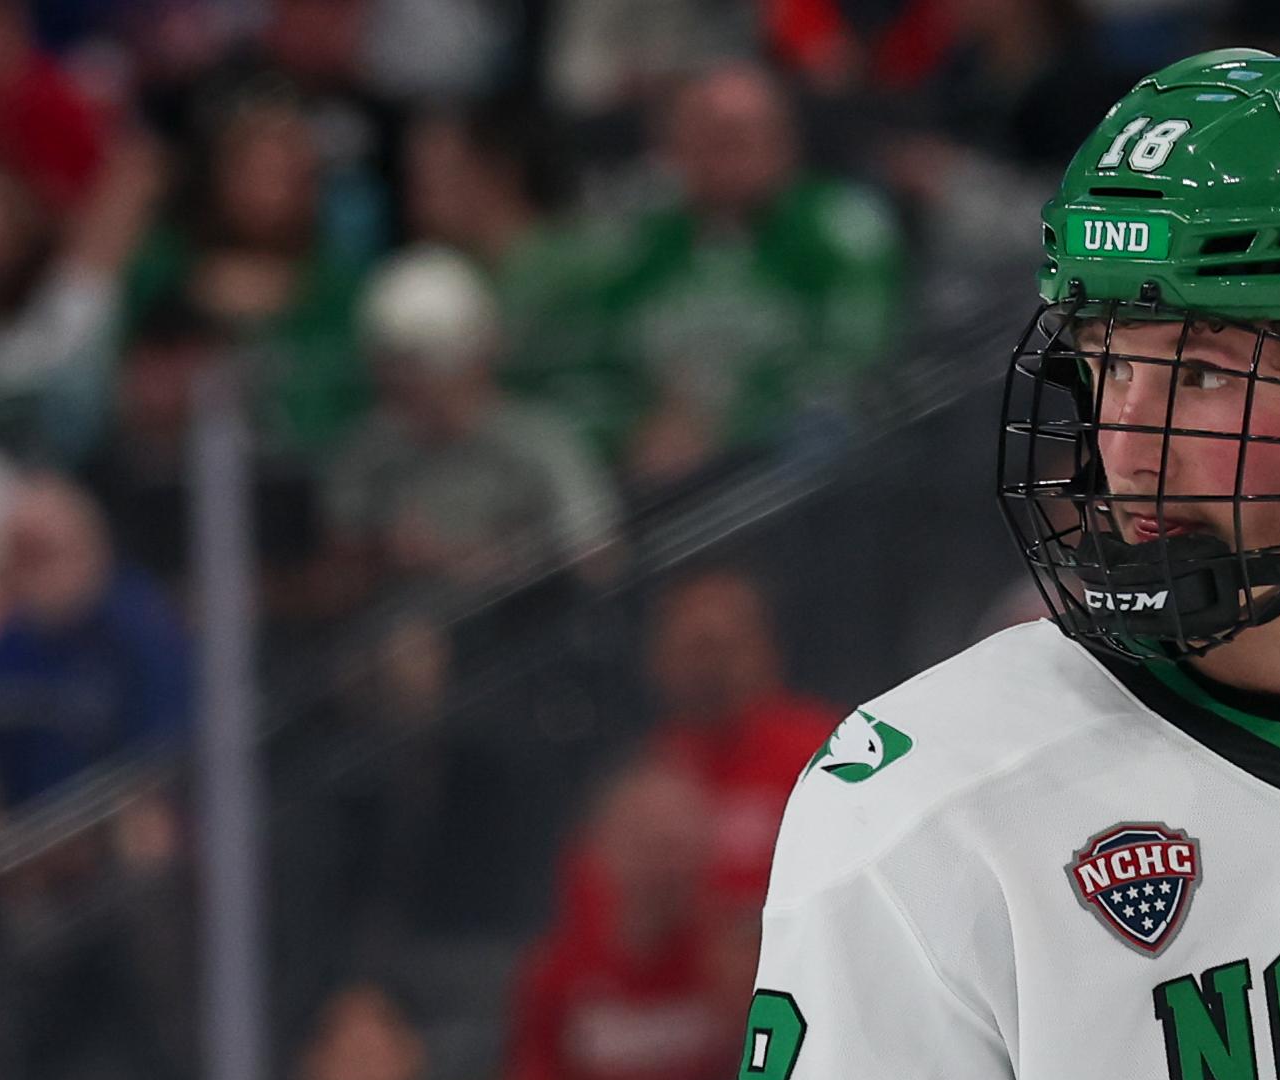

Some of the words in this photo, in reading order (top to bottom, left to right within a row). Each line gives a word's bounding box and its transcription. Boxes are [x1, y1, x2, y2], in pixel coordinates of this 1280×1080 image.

[1096, 117, 1192, 172] 18
[1083, 219, 1150, 252] UND
[1084, 588, 1169, 611] CCM
[1078, 844, 1192, 894] NCHC
